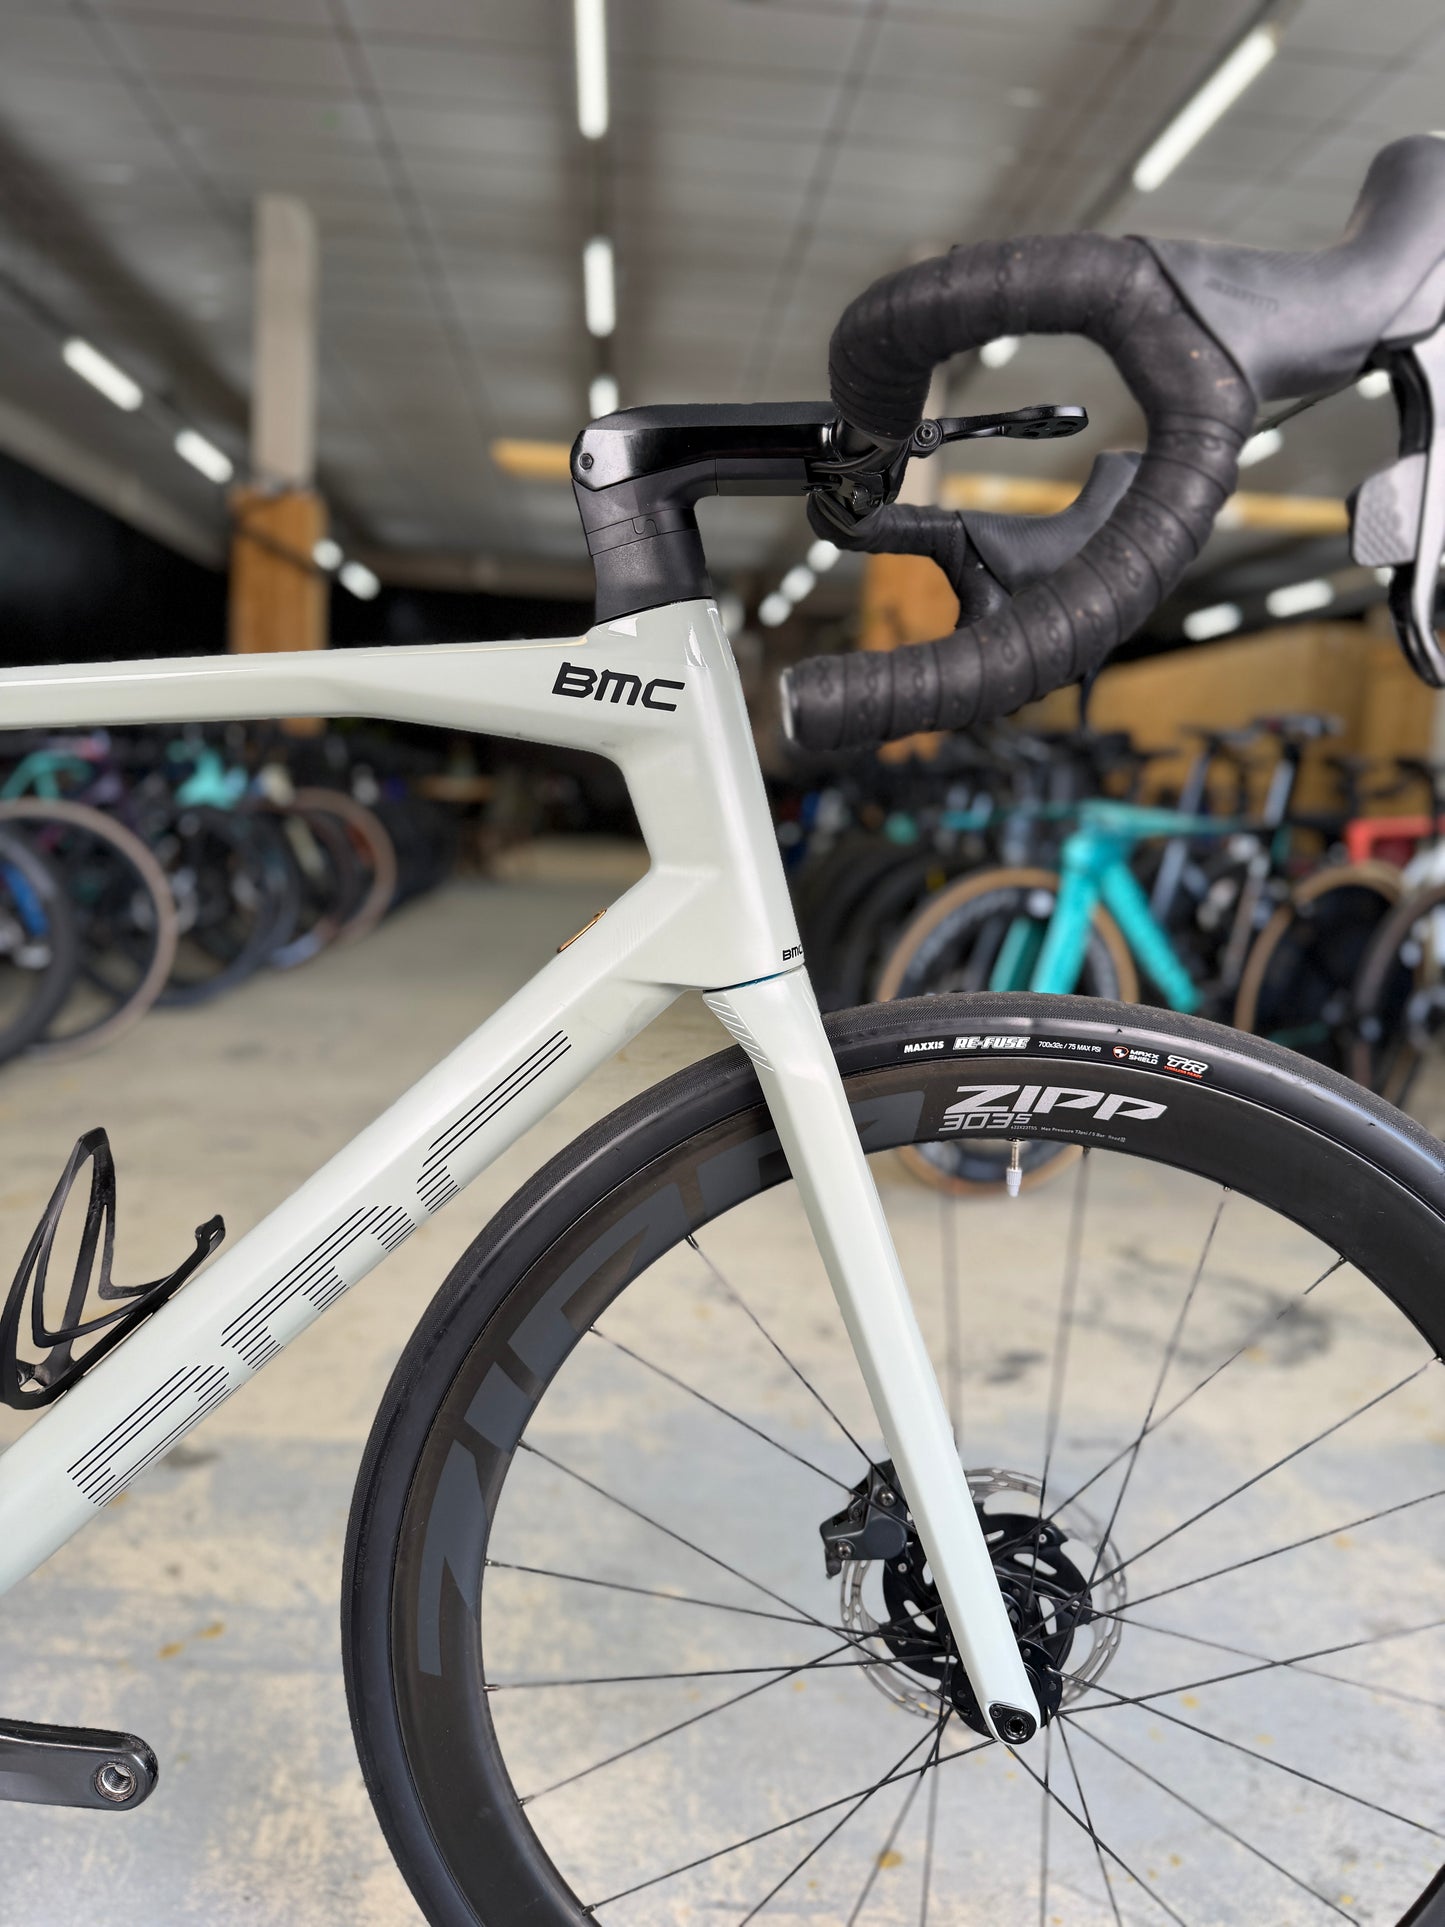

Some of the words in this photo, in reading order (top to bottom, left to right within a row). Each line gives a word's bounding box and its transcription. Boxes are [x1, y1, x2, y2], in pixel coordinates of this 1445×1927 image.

[551, 661, 686, 712] BMC
[904, 1041, 944, 1053] MAXXIS
[952, 1036, 1031, 1050] RE-FUSE
[1076, 1044, 1091, 1052] MAX
[1091, 1045, 1102, 1053] PSI
[1128, 1055, 1159, 1065] SHIELD
[1129, 1049, 1160, 1060] MAXX
[945, 1084, 1168, 1121] ZIPP
